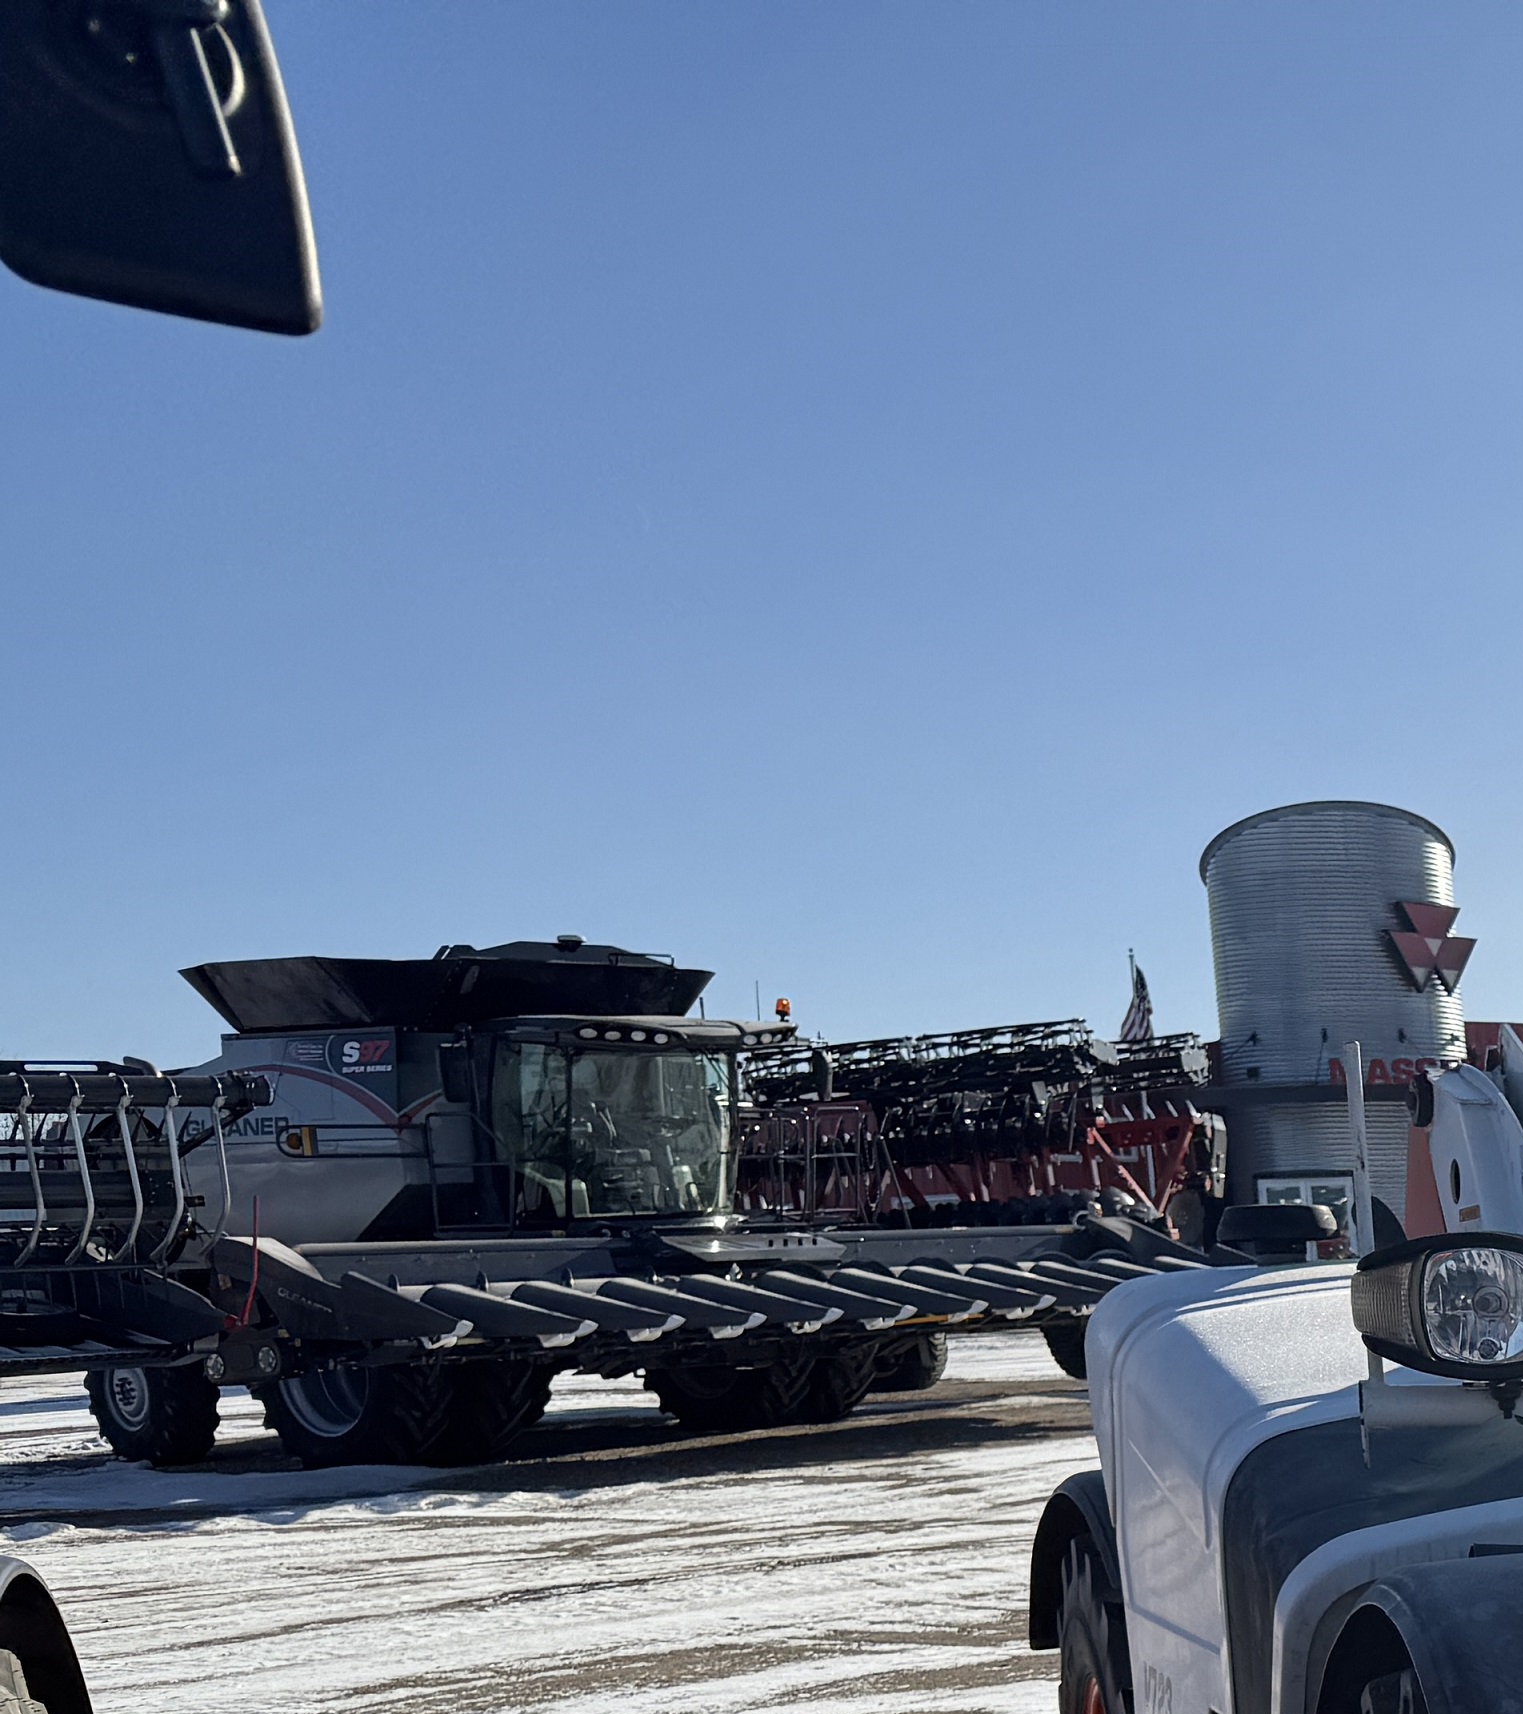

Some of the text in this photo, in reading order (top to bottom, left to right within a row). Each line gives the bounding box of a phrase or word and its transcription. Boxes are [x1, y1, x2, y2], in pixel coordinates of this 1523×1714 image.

[342, 1041, 390, 1063] S97
[1328, 1057, 1437, 1084] MASS
[186, 1116, 289, 1137] GLANER
